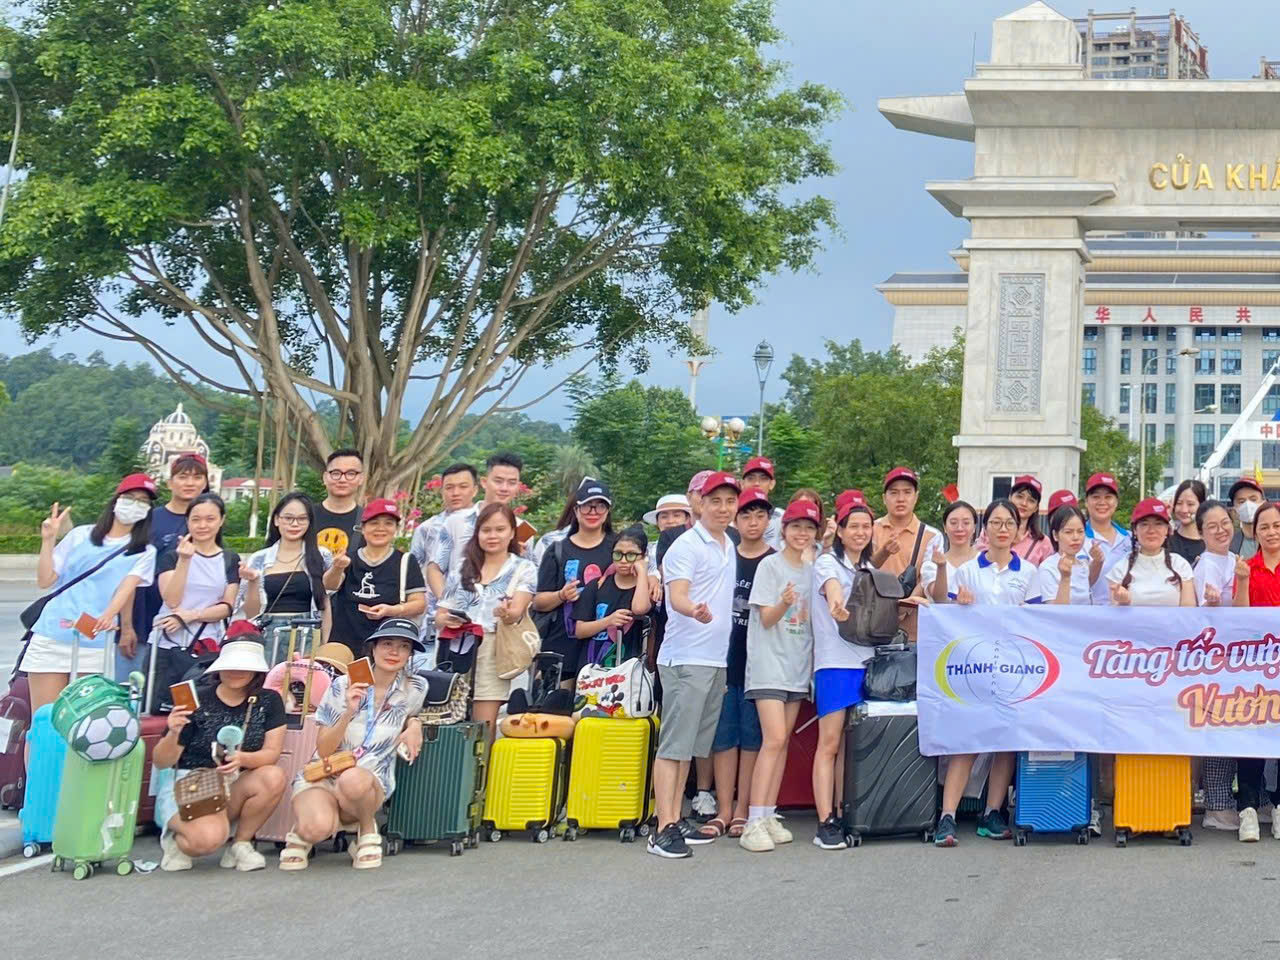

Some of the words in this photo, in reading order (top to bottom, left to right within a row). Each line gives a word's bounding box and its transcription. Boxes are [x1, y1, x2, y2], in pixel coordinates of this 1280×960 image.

[1149, 152, 1215, 191] CỬA
[946, 663, 993, 675] THANH
[1000, 664, 1045, 674] GIANG
[1085, 641, 1171, 685] Tăng
[1174, 628, 1223, 675] tốc
